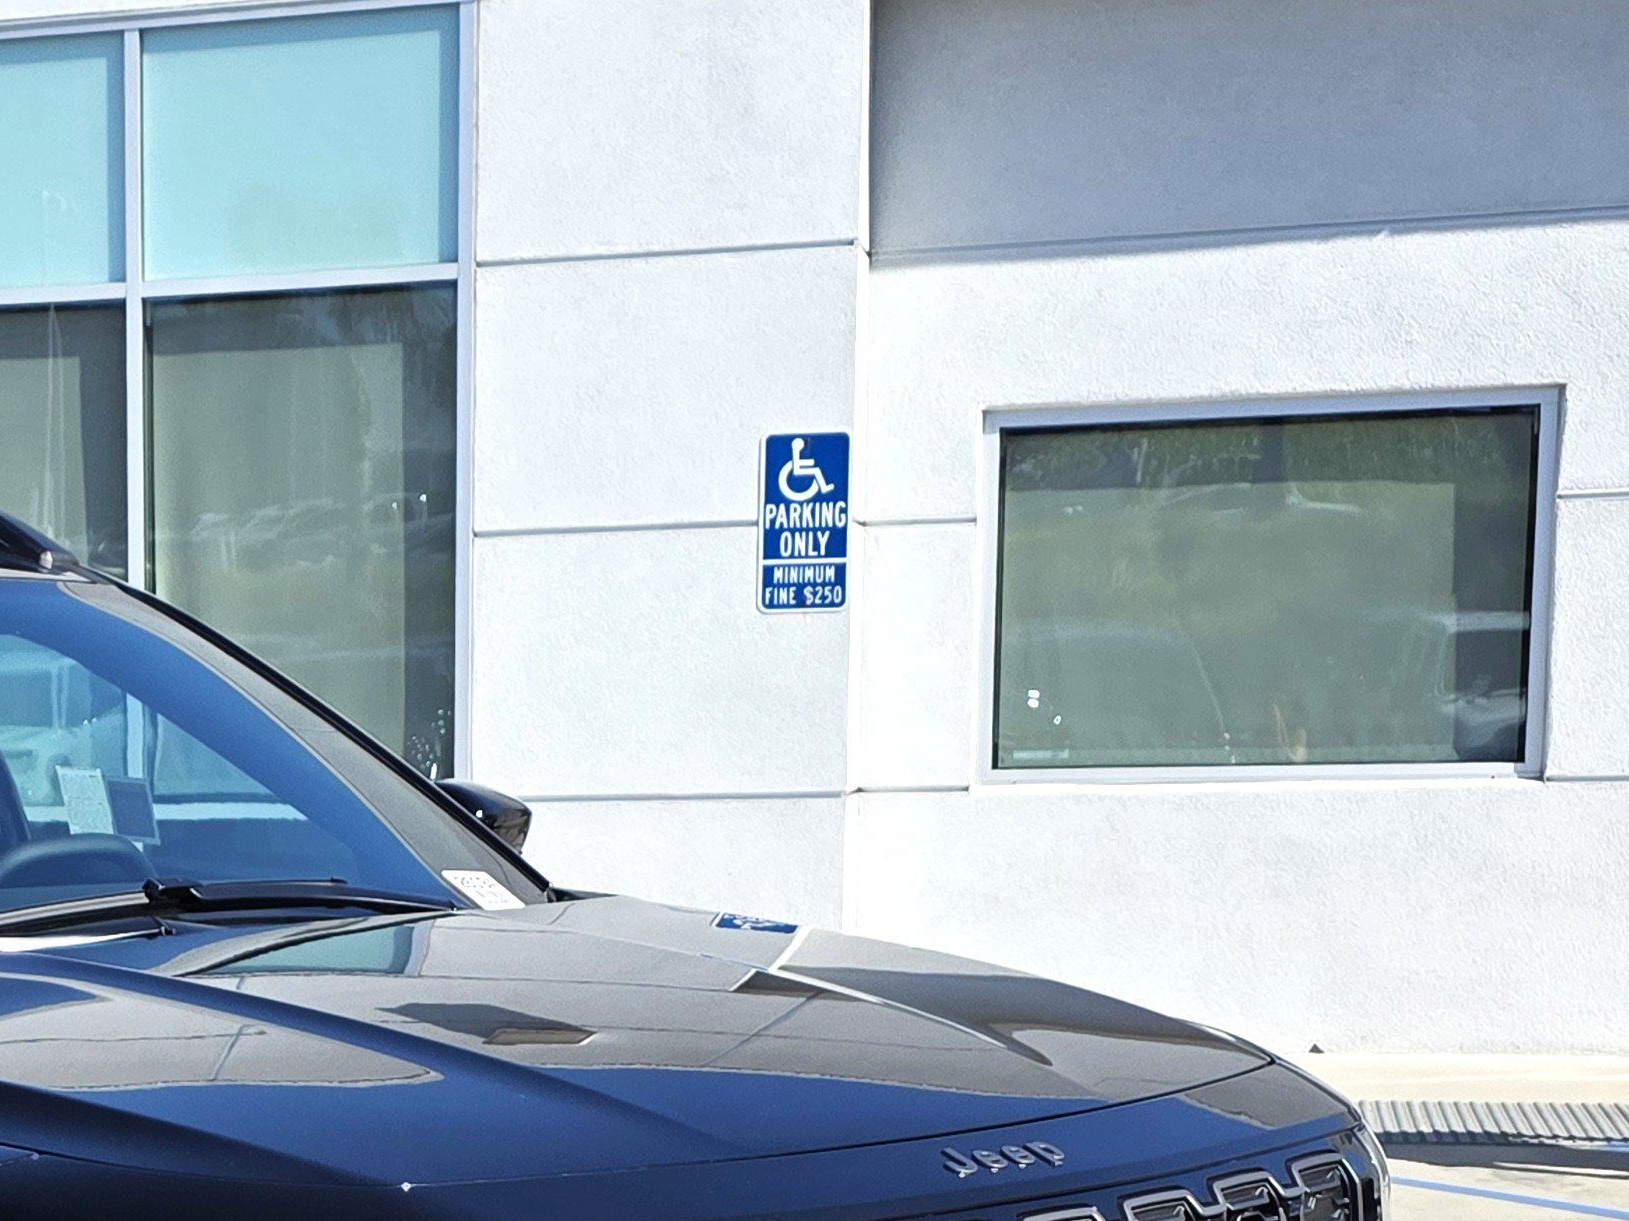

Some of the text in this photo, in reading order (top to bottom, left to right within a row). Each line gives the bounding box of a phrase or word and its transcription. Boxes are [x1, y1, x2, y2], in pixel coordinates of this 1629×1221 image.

[765, 501, 846, 529] PARKING
[780, 531, 830, 557] ONLY
[774, 565, 835, 584] MINIMUM
[765, 585, 842, 605] FINE $250
[940, 1141, 1065, 1178] Jeep
